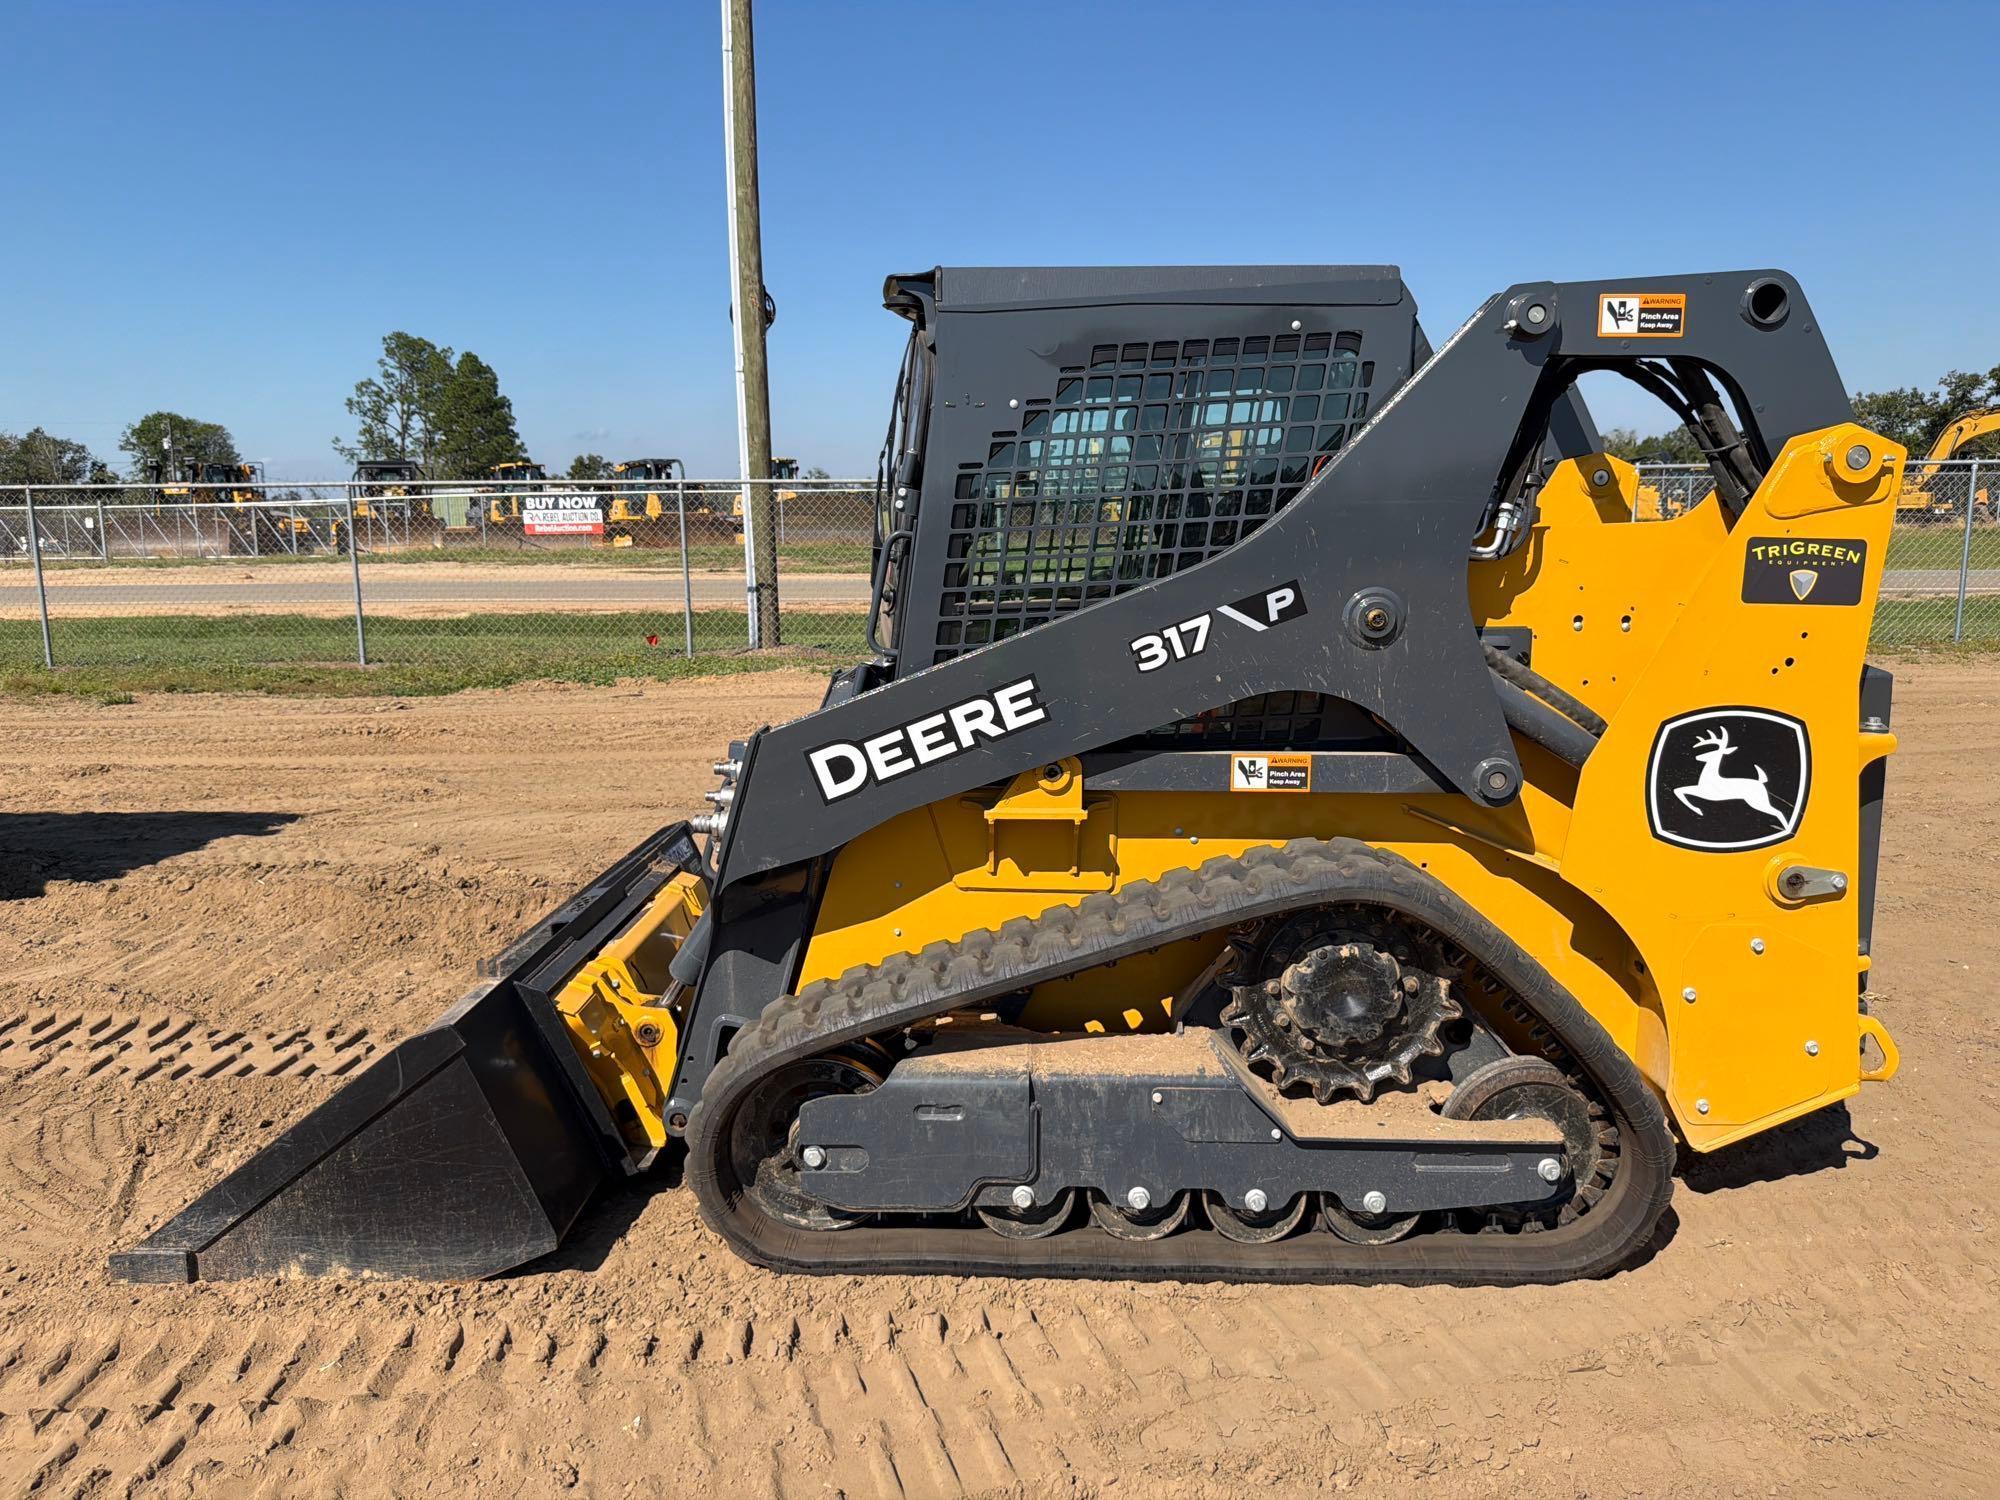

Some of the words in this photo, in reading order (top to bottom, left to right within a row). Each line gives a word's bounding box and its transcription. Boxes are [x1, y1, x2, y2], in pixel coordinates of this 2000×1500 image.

[1640, 312, 1661, 320] Pinch
[525, 497, 555, 509] BUY
[559, 497, 597, 509] NOW
[542, 512, 560, 522] REBEL
[562, 512, 588, 521] AUCTION
[1752, 541, 1860, 564] TRIGREEN
[1132, 615, 1210, 670] 317
[1267, 589, 1294, 621] P
[810, 680, 1044, 799] DEERE
